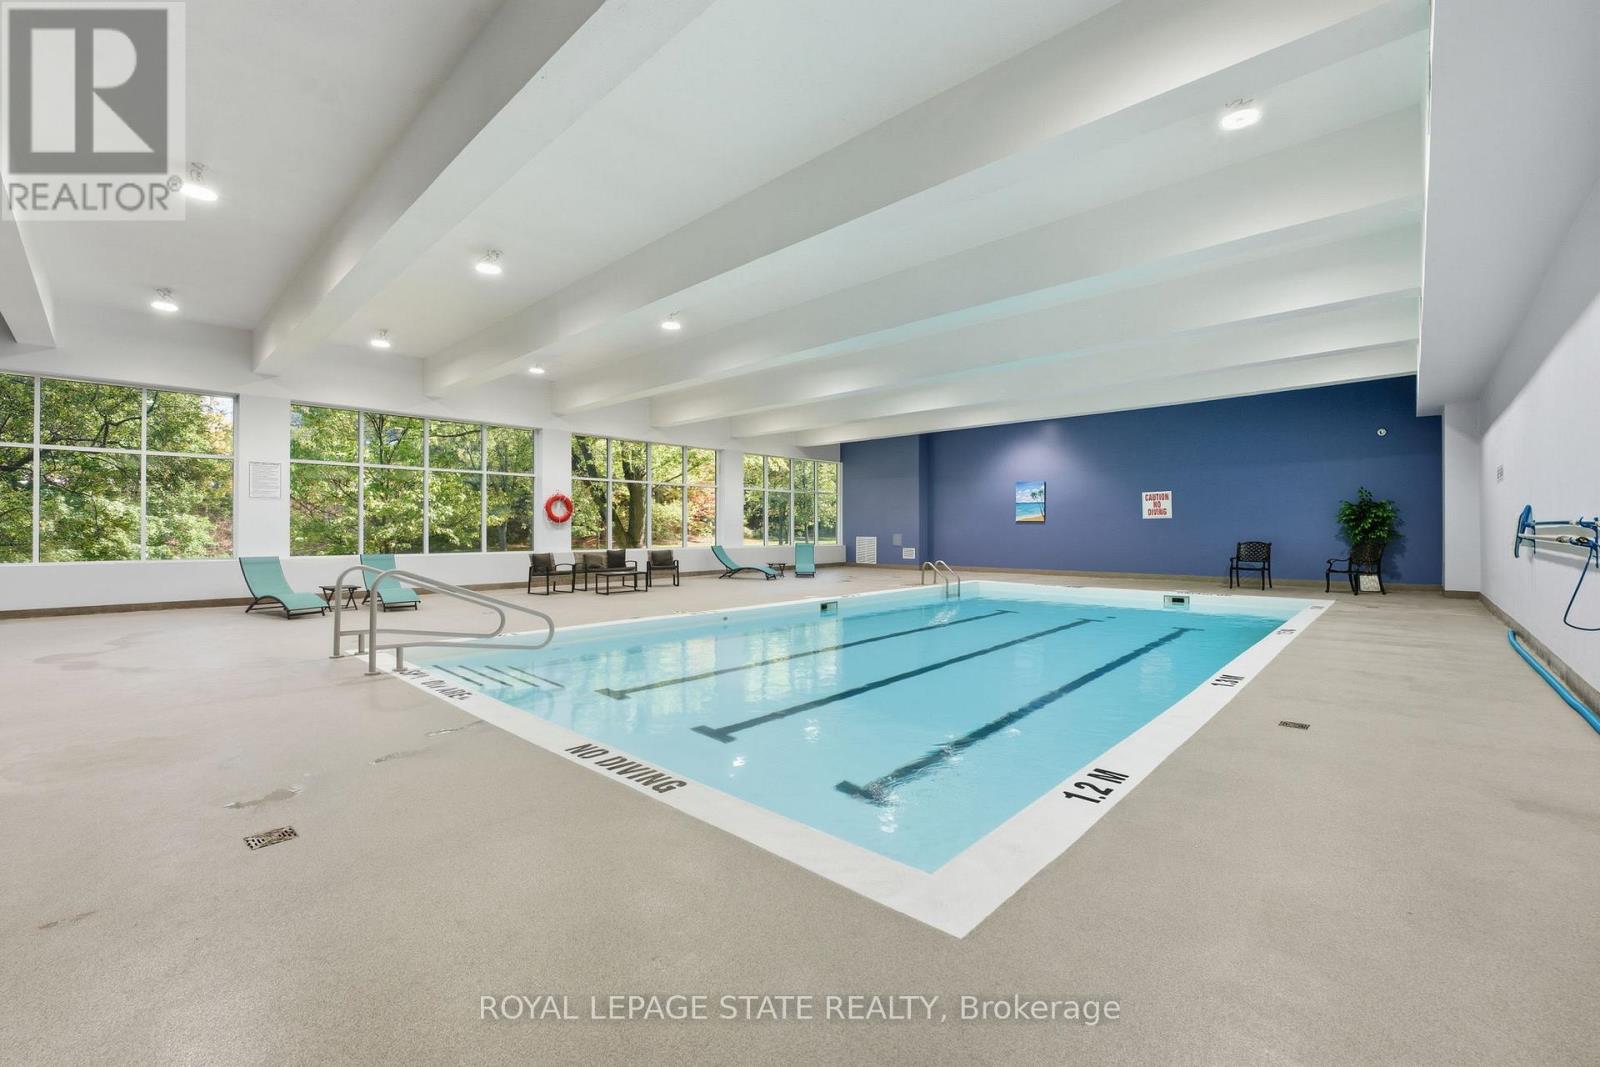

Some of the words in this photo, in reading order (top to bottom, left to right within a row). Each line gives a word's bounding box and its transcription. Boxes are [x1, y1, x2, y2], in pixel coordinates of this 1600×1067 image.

[1144, 493, 1169, 502] CAUTION
[1147, 508, 1168, 516] DIVING
[564, 743, 610, 759] NO
[594, 756, 688, 794] DIVING
